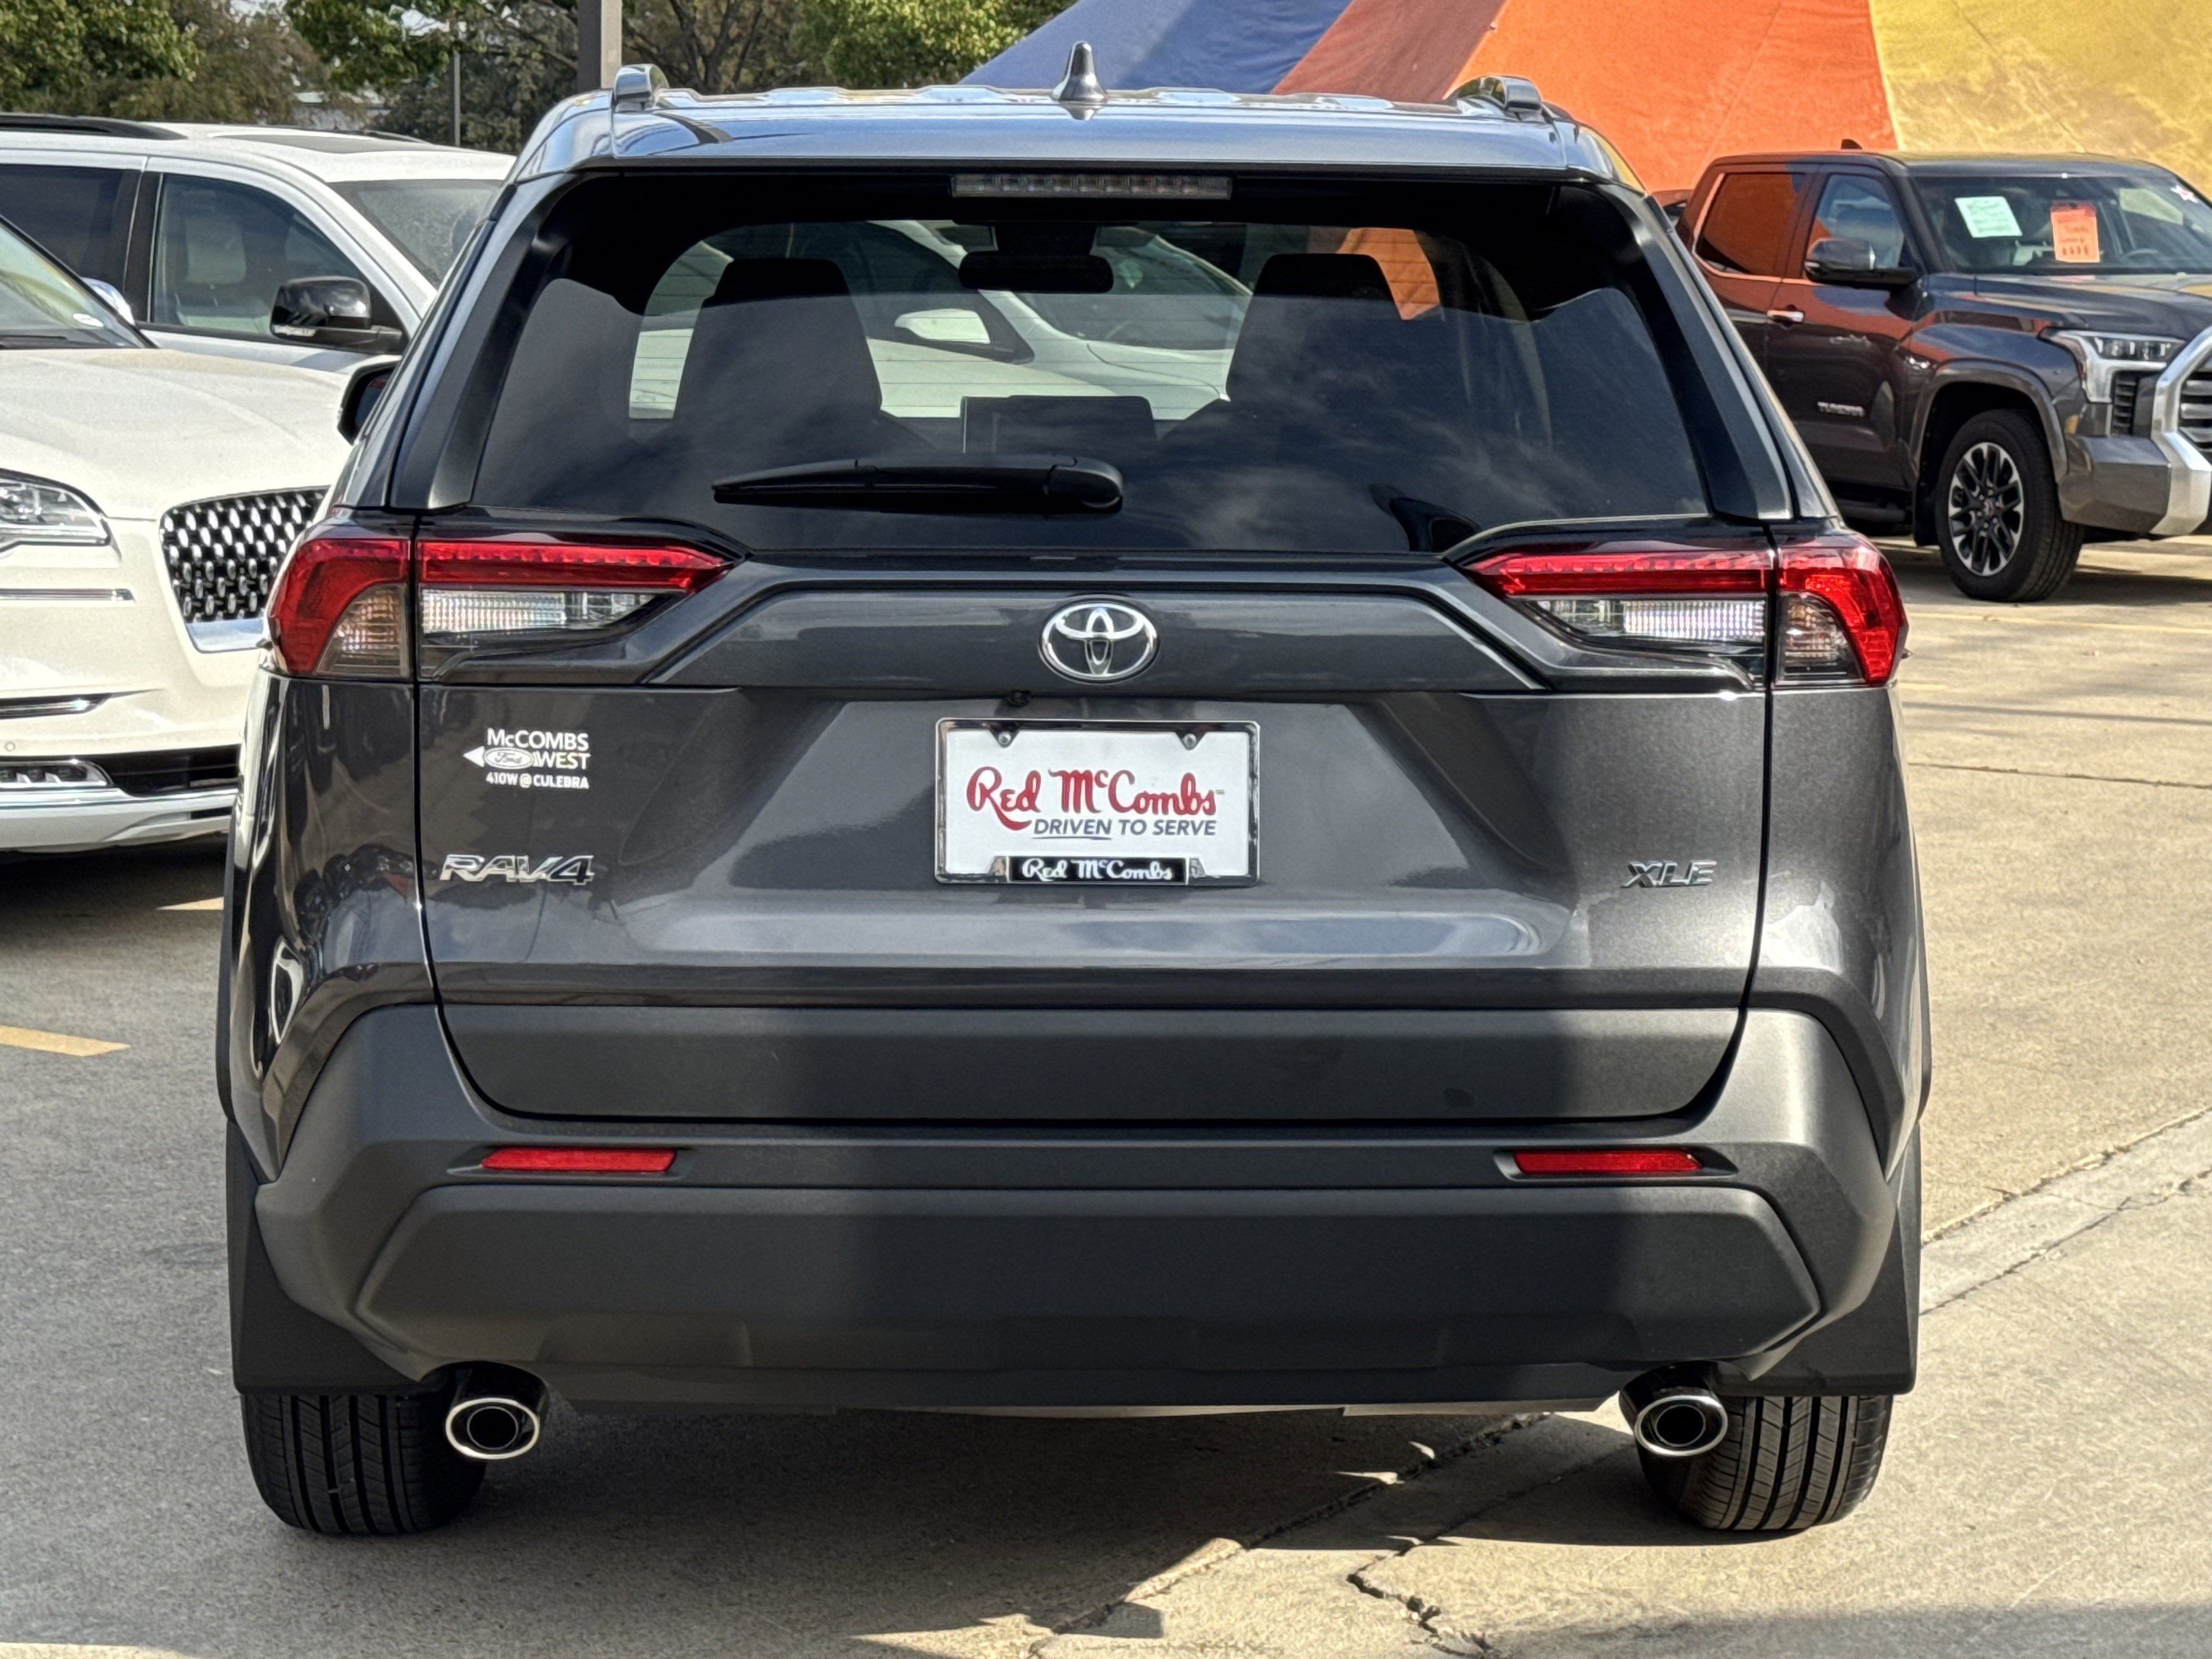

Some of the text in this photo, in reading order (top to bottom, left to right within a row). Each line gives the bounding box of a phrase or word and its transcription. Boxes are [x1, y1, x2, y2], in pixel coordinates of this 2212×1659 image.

[487, 727, 589, 751] McCOMBS
[532, 751, 591, 770] WEST
[967, 766, 1217, 831] Red McCombs
[1033, 819, 1217, 836] DRIVEN TO SERVE
[439, 854, 595, 885] RAV4
[1022, 857, 1173, 882] Red McCombs
[1620, 860, 1718, 888] XLE
